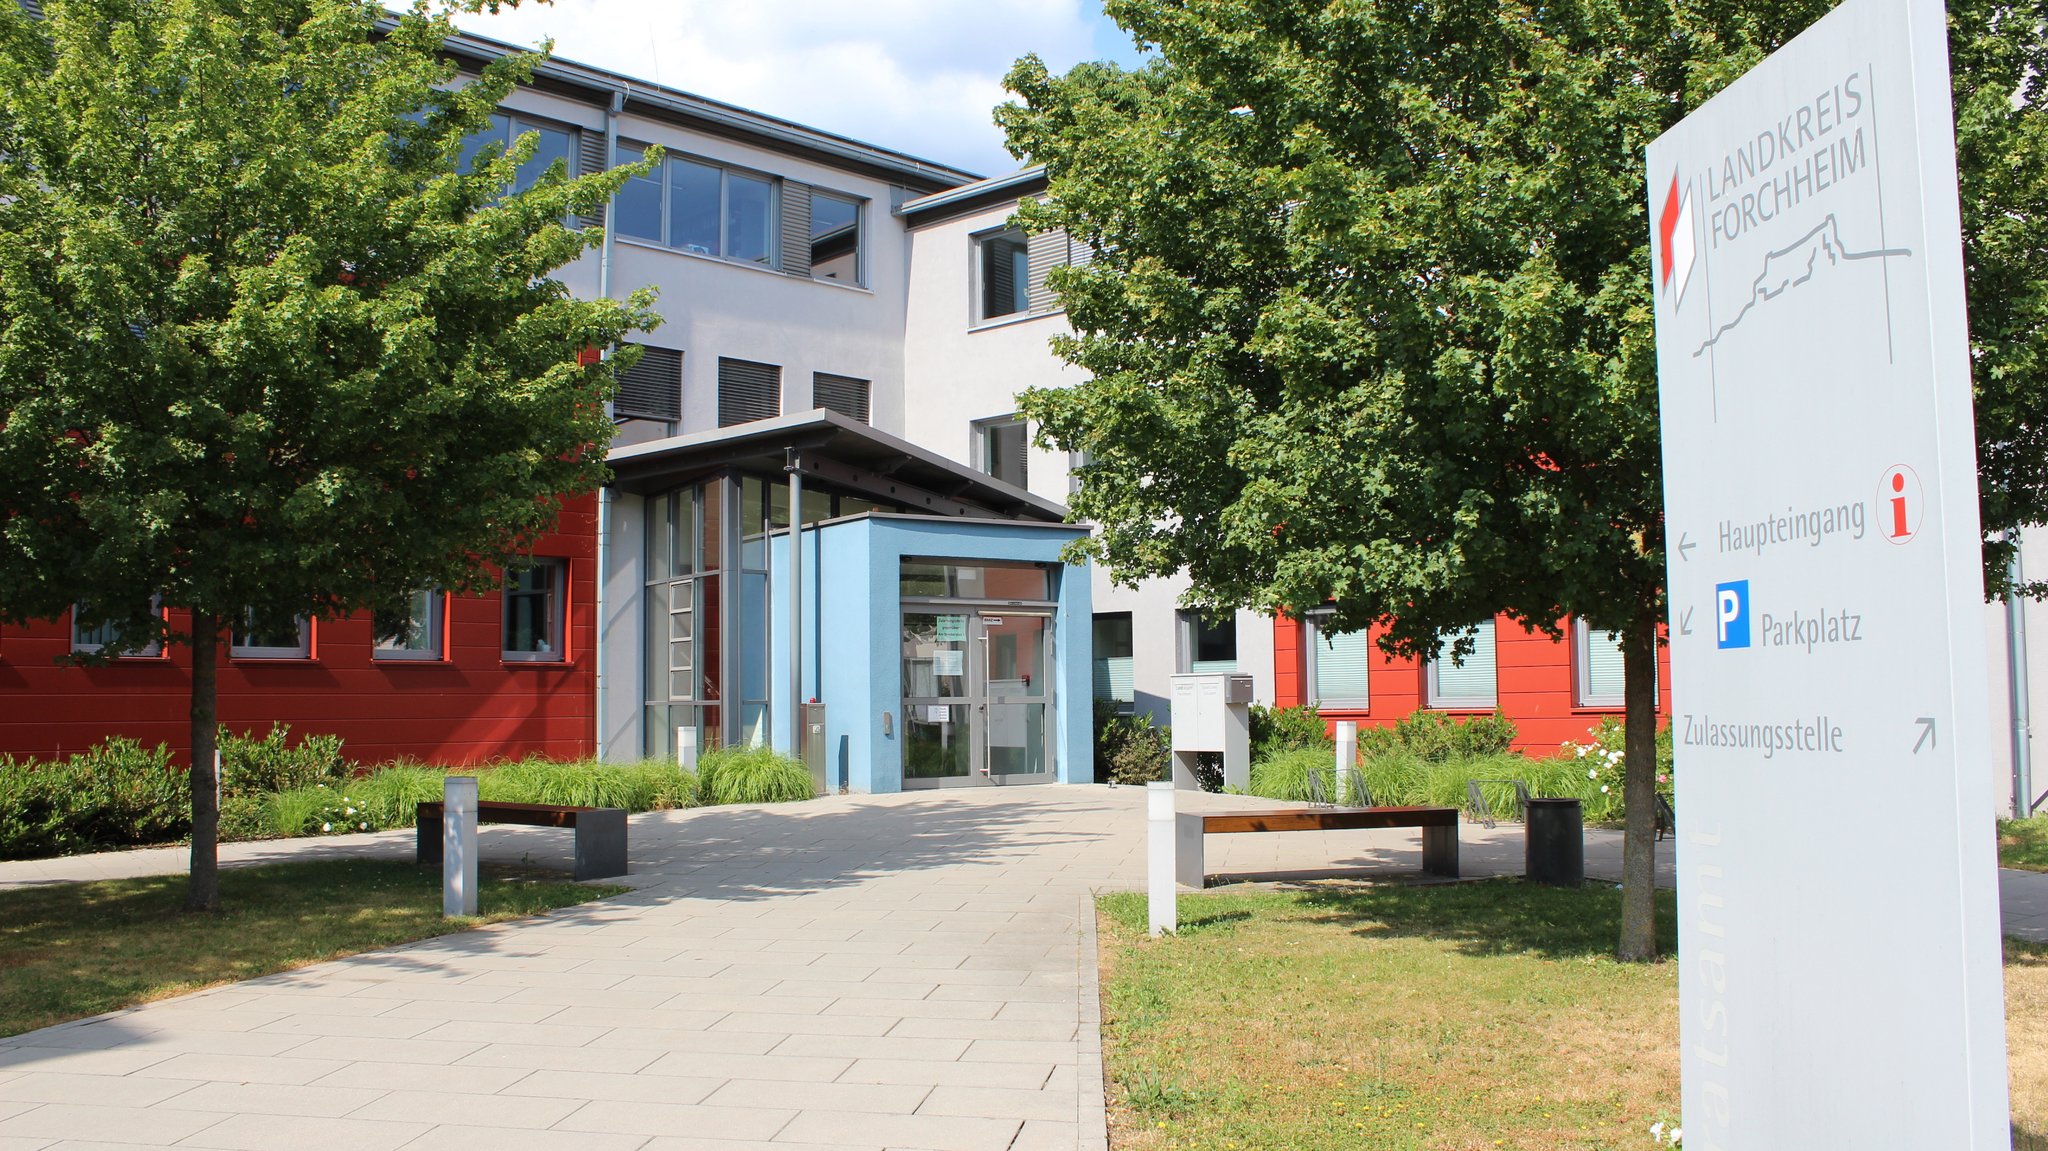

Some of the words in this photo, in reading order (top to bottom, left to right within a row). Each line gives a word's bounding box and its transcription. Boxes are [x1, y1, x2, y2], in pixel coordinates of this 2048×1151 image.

[1708, 72, 1863, 203] LANDKREIS
[1711, 127, 1867, 250] FORCHHEIM
[1718, 500, 1866, 556] Haupteingang
[1718, 590, 1740, 642] P
[1762, 608, 1863, 654] Parkplatz
[1683, 714, 1844, 759] Zulassungsstelle
